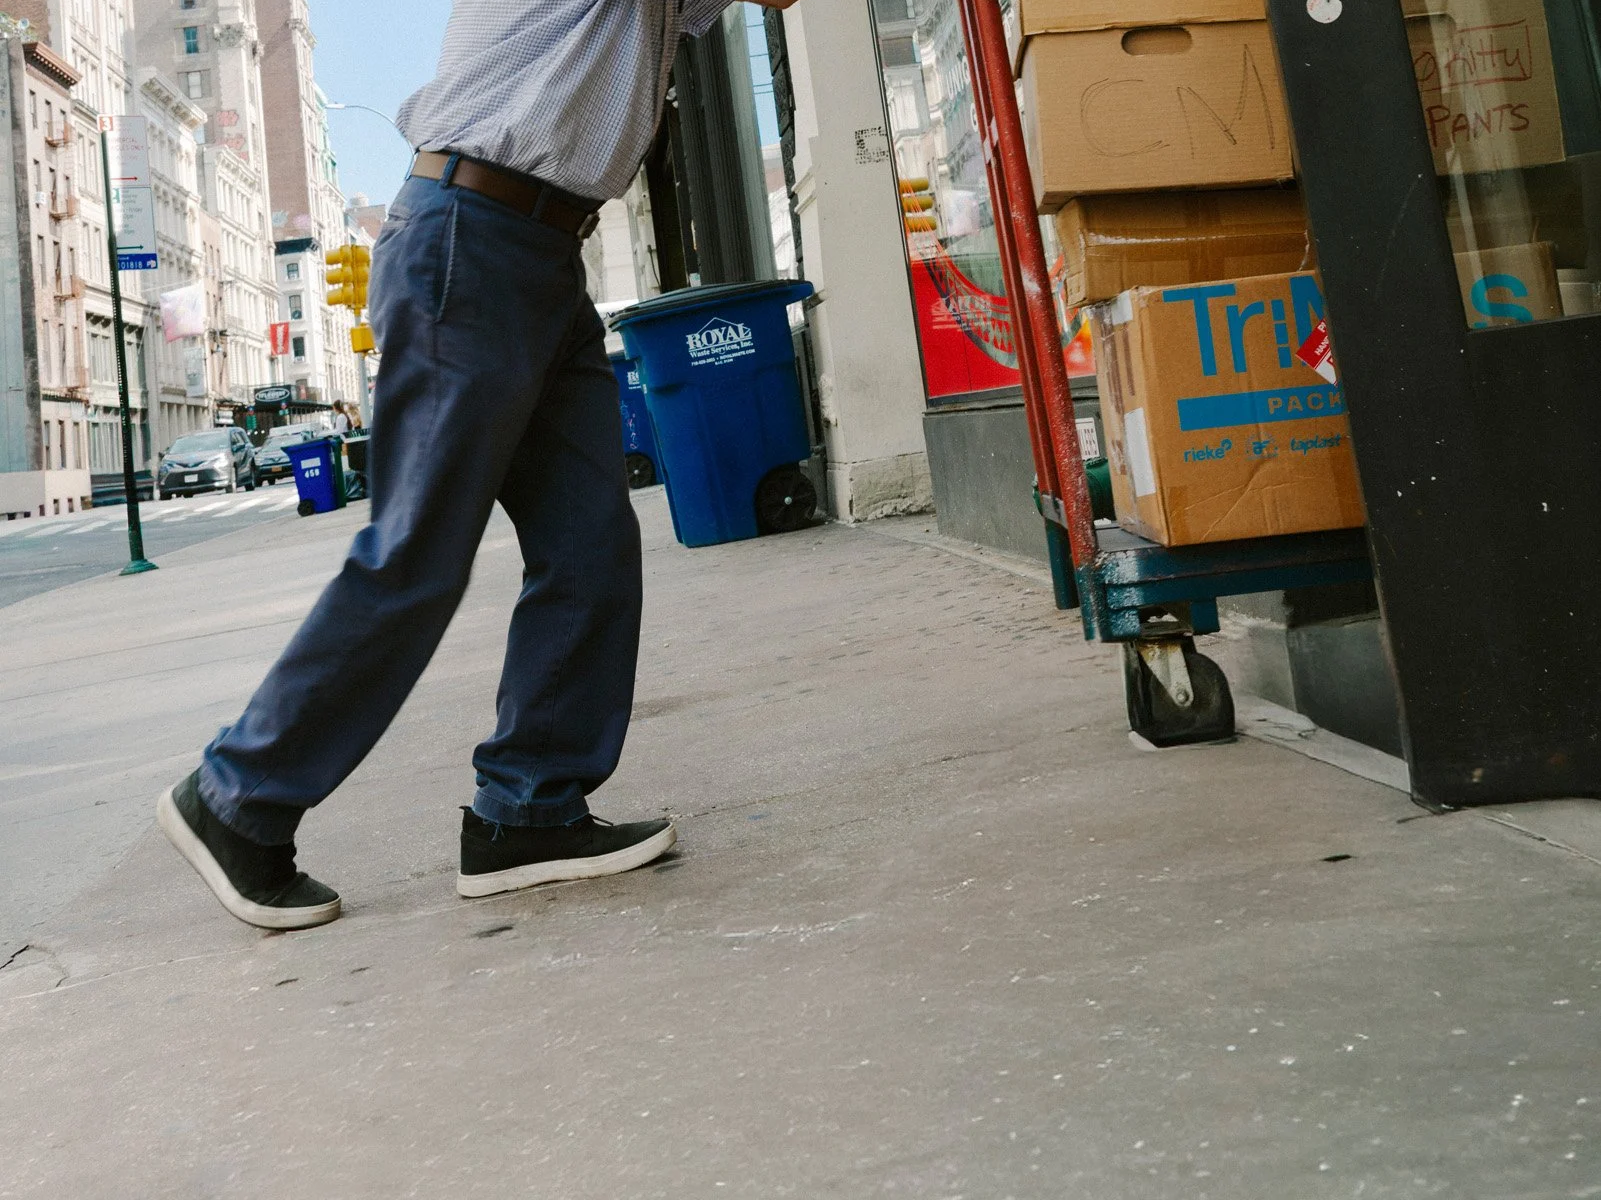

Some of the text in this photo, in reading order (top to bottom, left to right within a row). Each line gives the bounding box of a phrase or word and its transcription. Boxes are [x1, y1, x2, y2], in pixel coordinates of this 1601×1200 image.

[1425, 103, 1530, 149] PANTS
[686, 323, 753, 350] ROYAL
[689, 350, 710, 358] Waste
[1183, 442, 1226, 463] rieke
[1290, 433, 1342, 456] taplast
